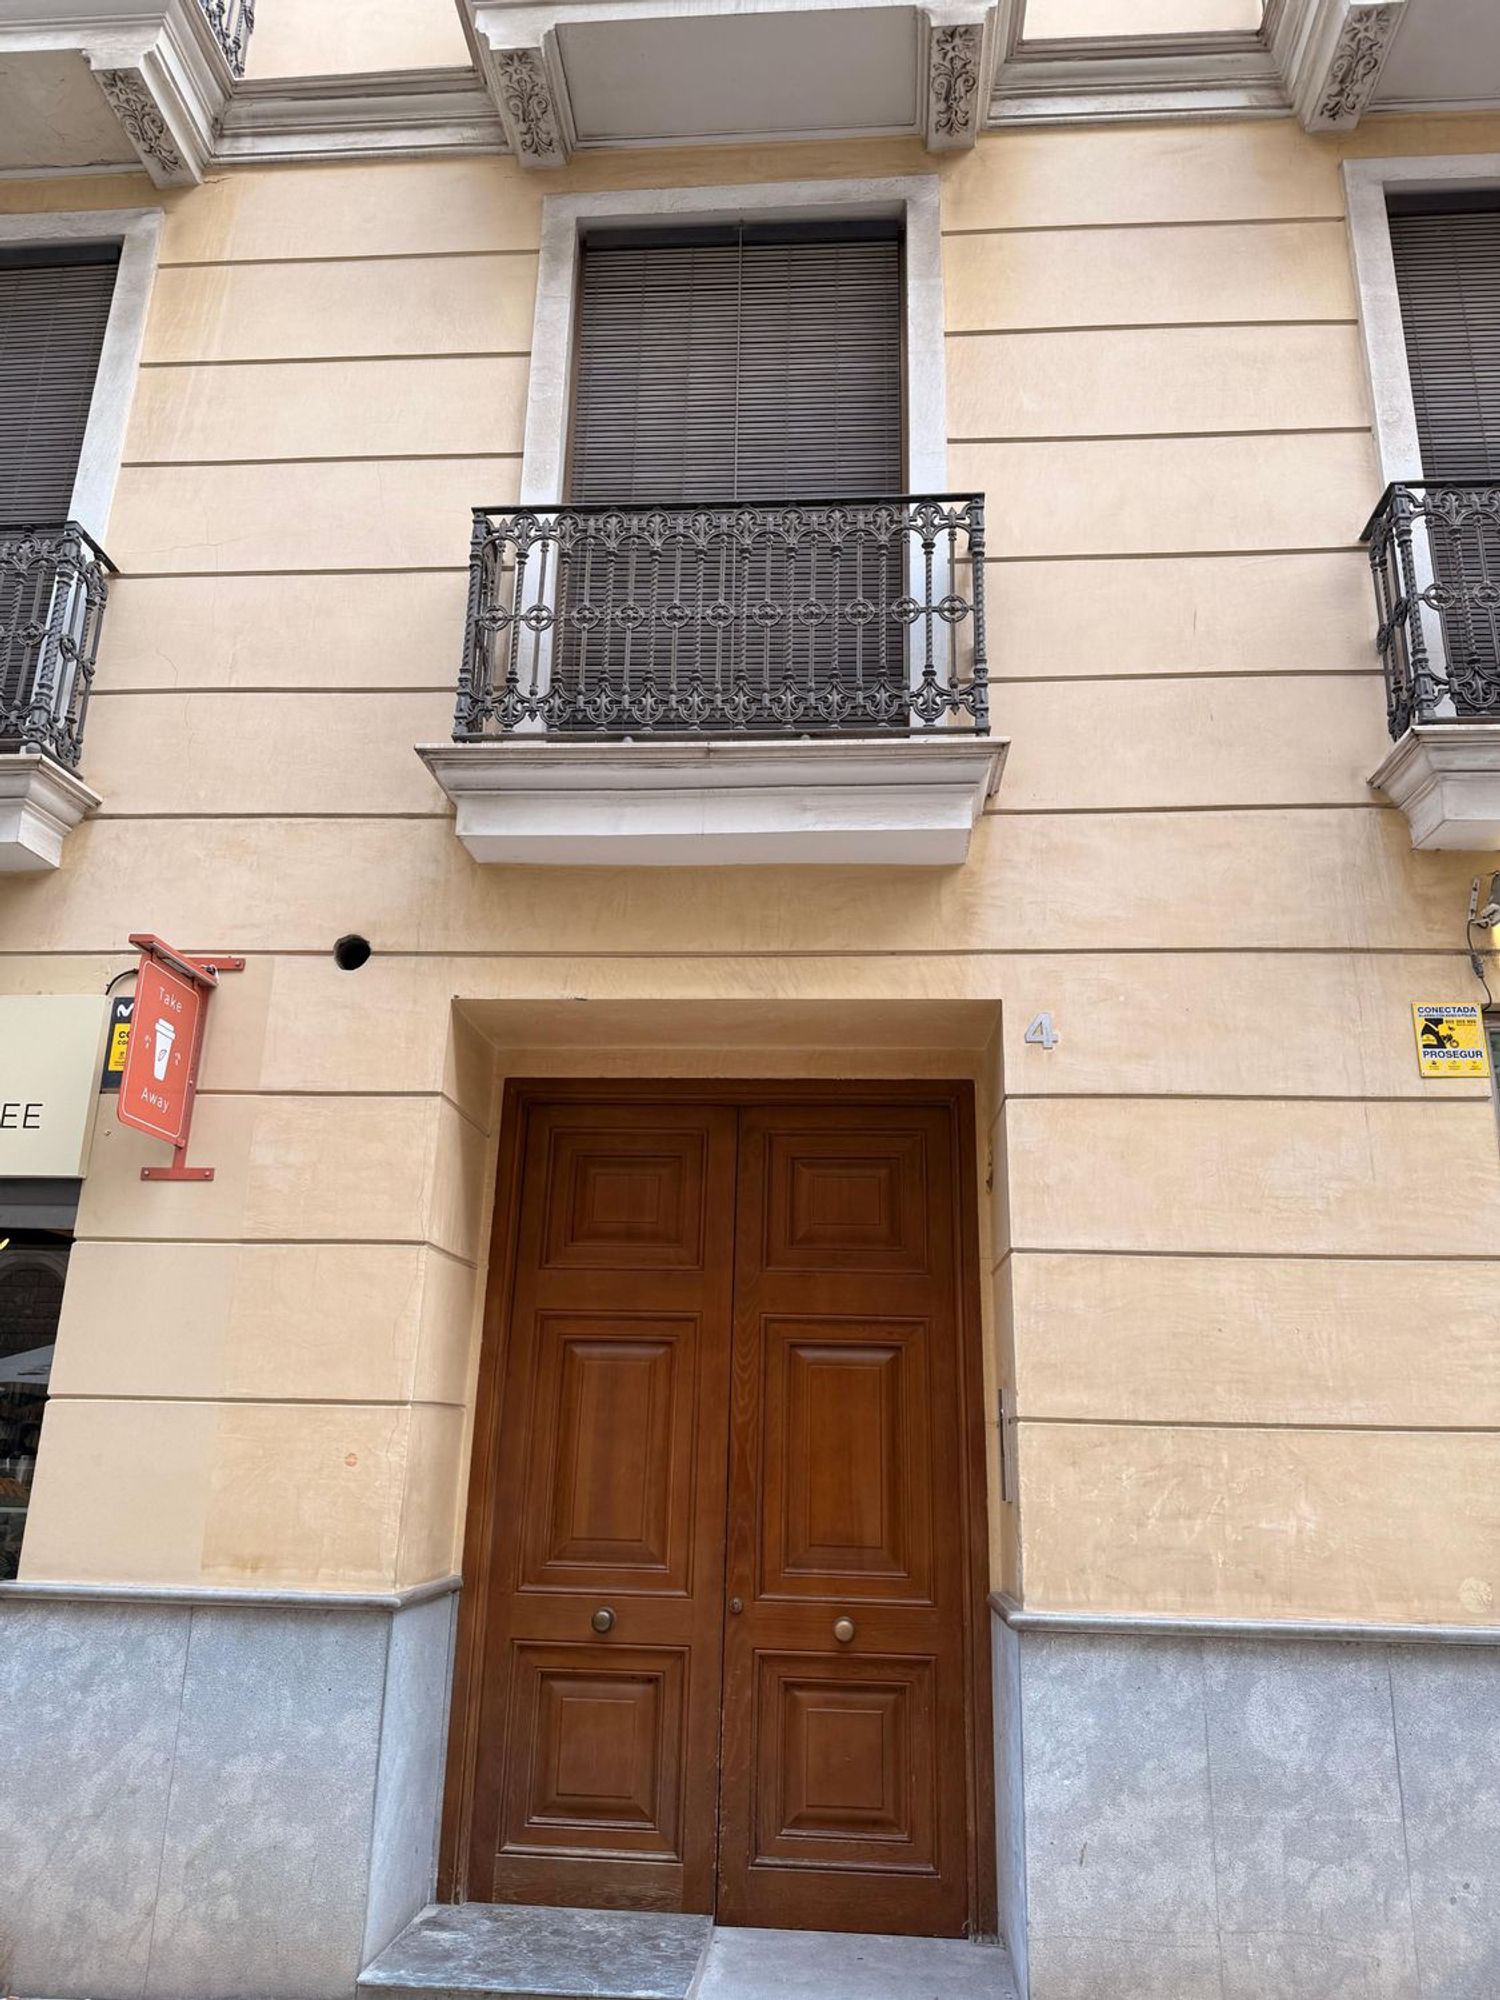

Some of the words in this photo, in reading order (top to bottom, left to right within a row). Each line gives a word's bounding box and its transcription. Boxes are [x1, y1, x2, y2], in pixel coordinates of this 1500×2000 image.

[159, 986, 182, 1013] Take
[1417, 1006, 1477, 1014] CONECTADA
[1024, 1012, 1059, 1050] 4
[1422, 1050, 1483, 1059] PROSEGUR
[141, 1088, 169, 1114] Away
